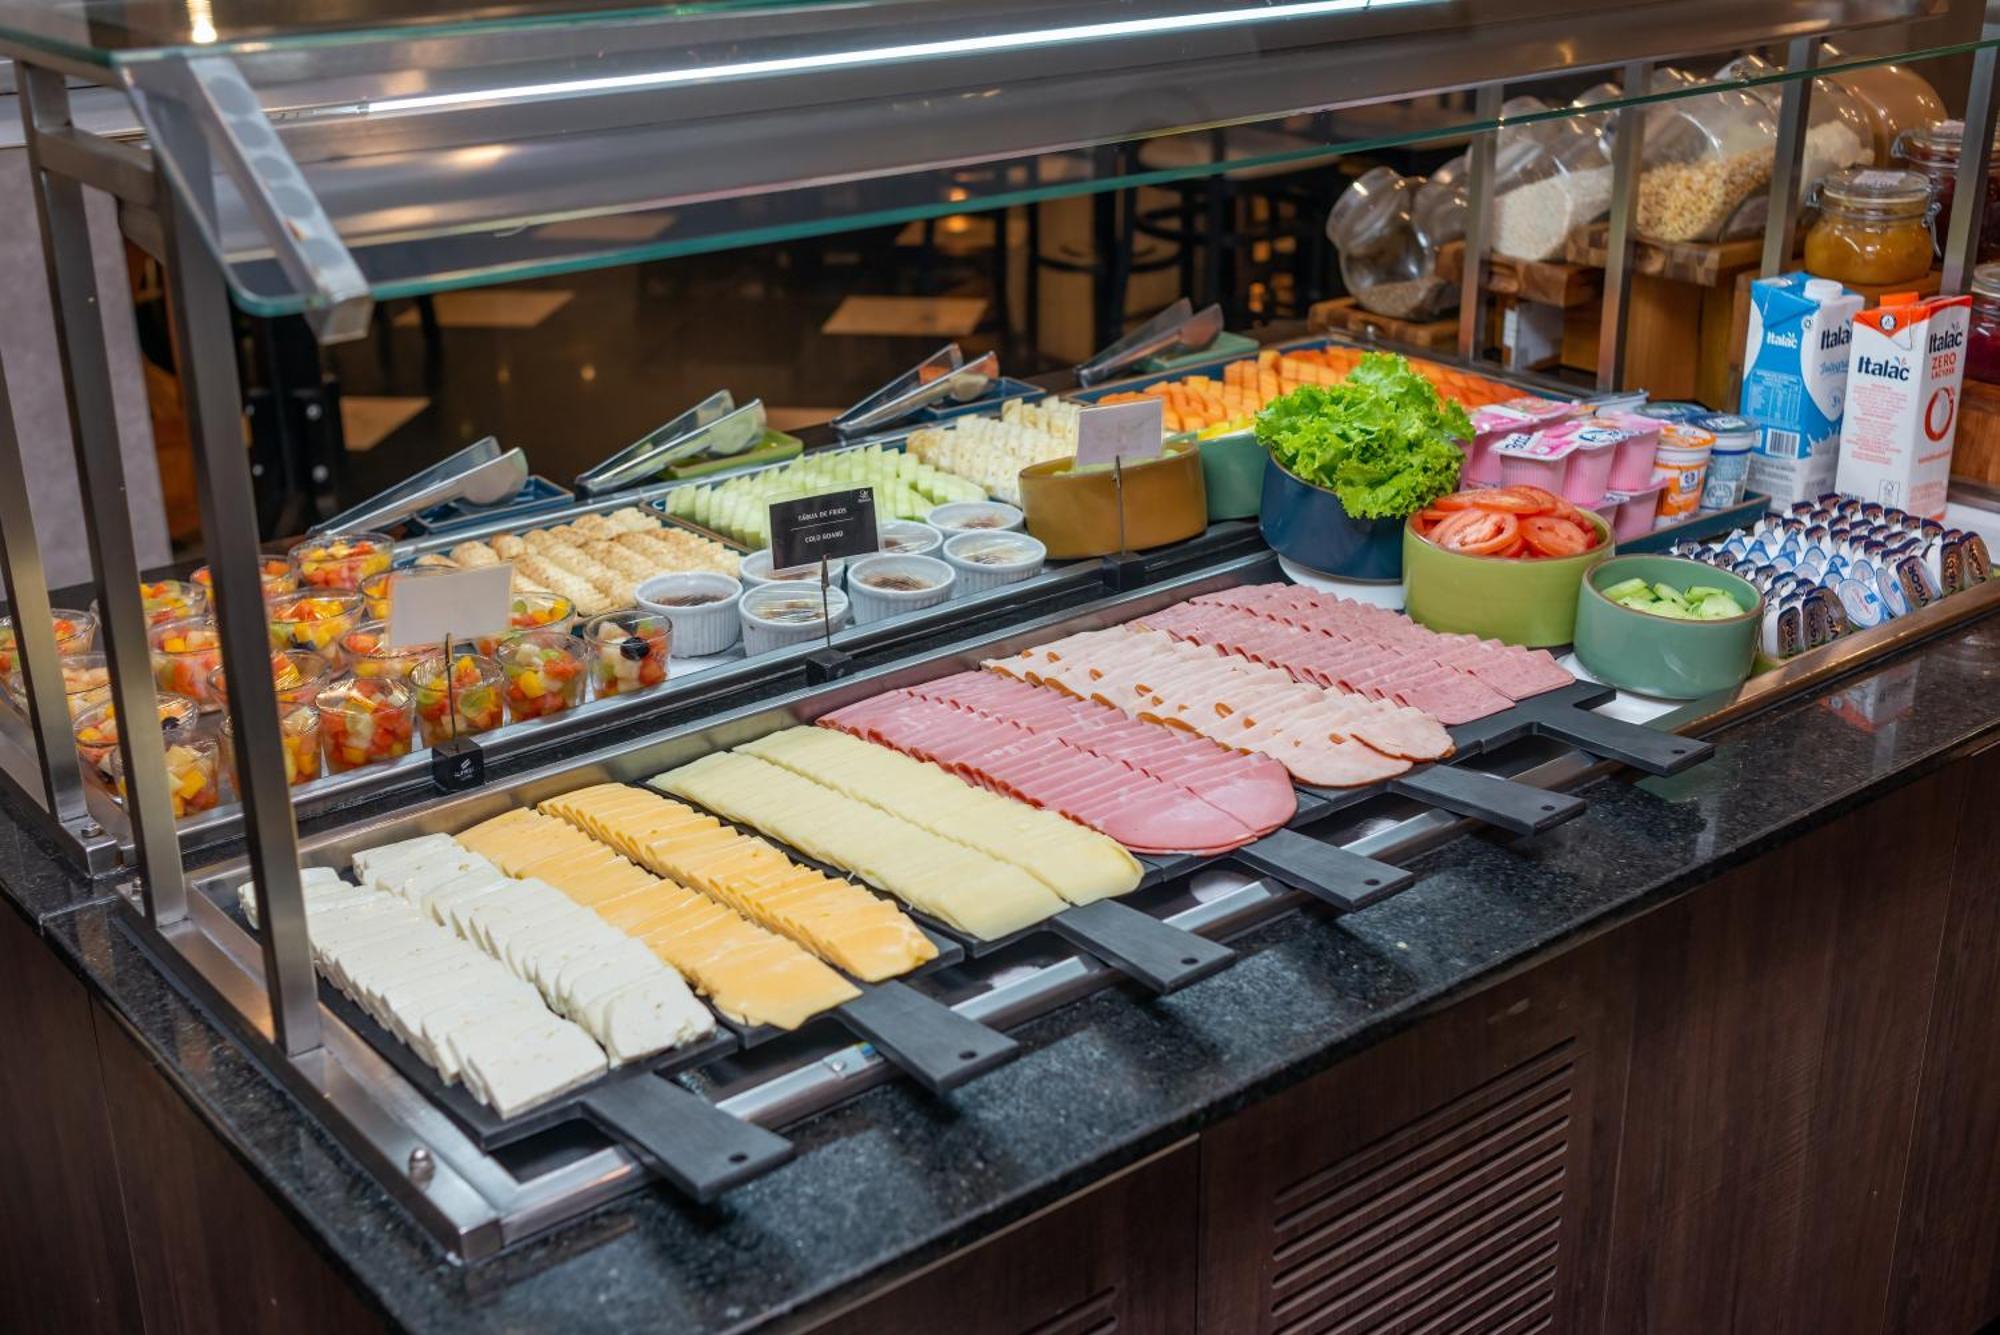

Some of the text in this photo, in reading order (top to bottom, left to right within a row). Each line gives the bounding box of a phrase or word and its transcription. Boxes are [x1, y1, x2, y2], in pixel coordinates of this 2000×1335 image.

[1767, 331, 1798, 349] Italac
[1821, 326, 1851, 350] Itala
[1929, 329, 1962, 353] Italac
[1857, 356, 1910, 381] Italac
[1931, 352, 1957, 369] ZERO
[819, 510, 828, 518] DE
[804, 534, 821, 544] COLD
[1908, 563, 1929, 607] VIGOR
